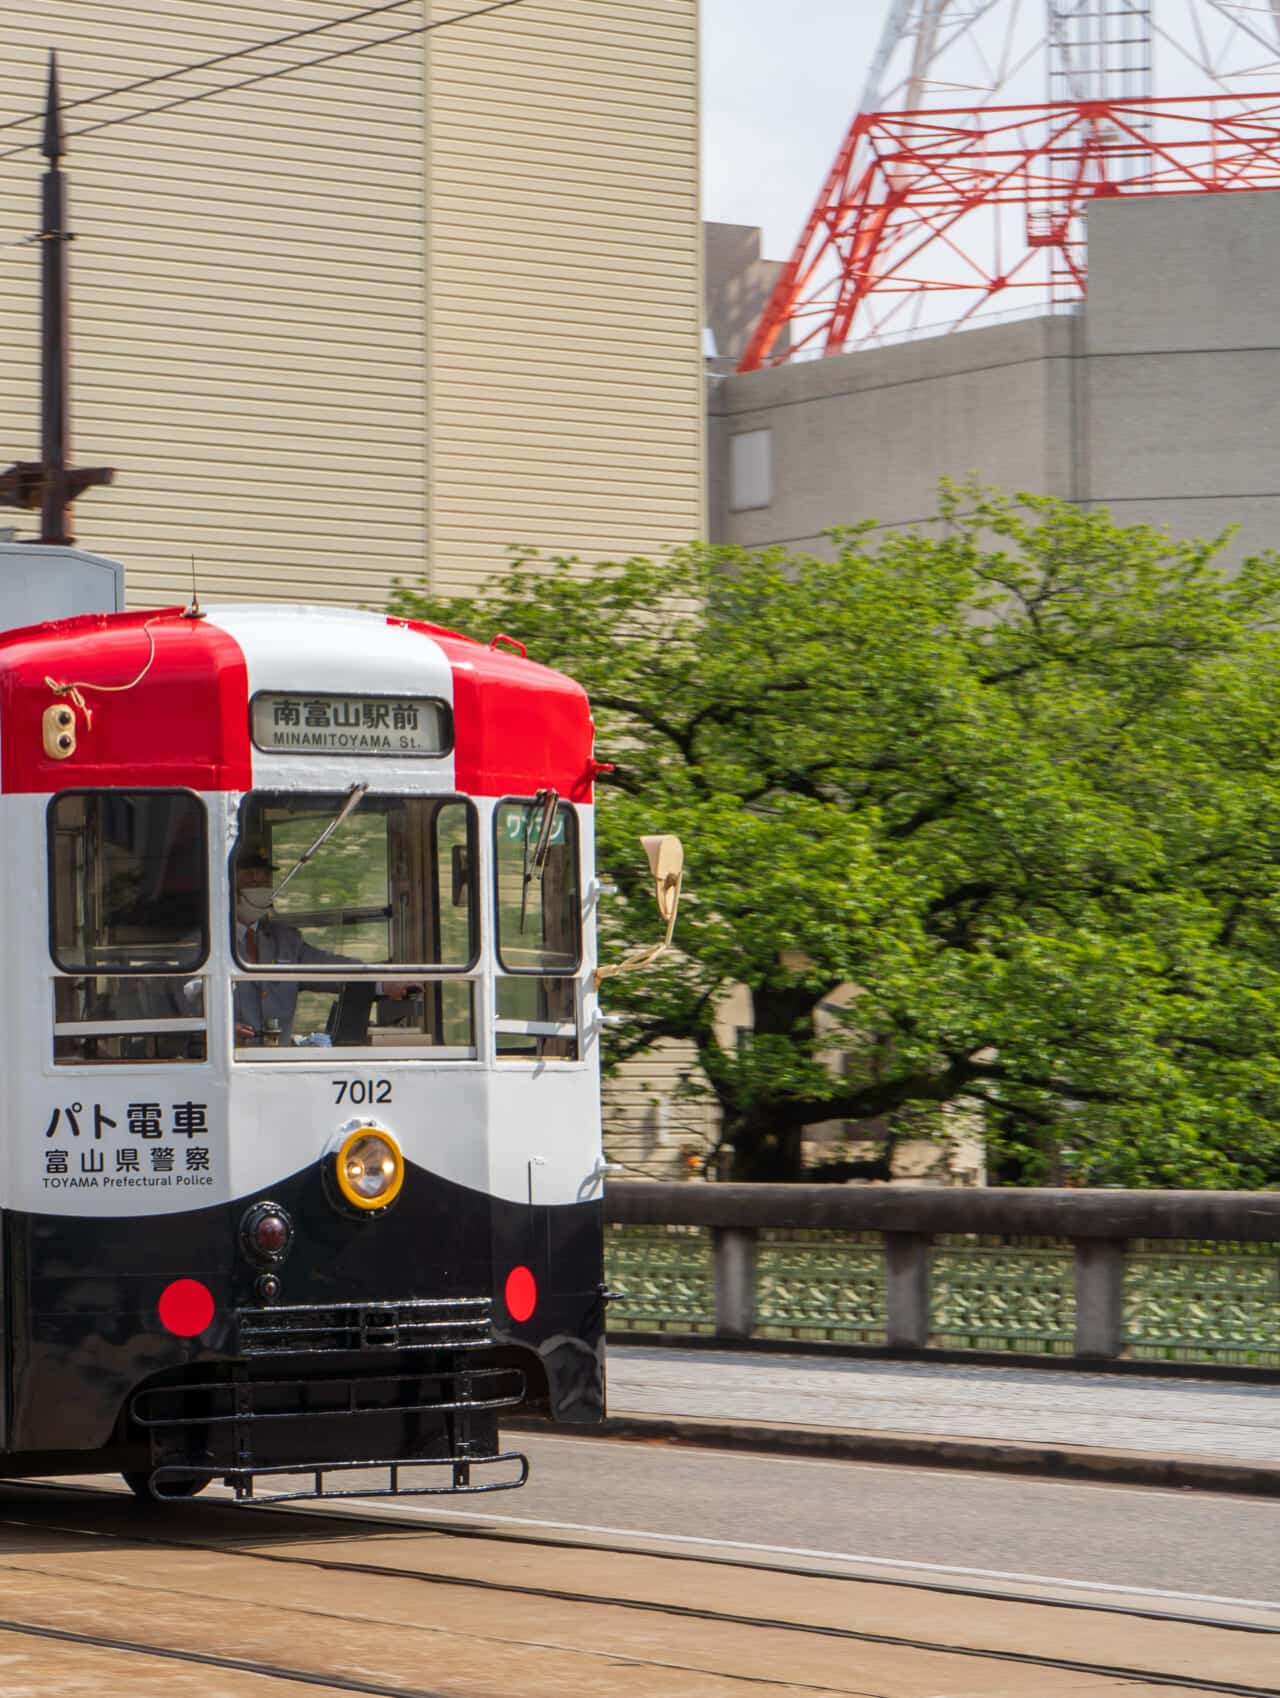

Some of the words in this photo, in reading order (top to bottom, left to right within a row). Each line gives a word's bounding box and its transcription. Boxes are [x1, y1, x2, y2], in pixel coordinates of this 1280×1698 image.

[272, 700, 419, 730] 南富山駅前
[273, 731, 391, 749] MINAMITOYAMA
[332, 1079, 392, 1104] 7012
[45, 1101, 208, 1140] パト電車
[45, 1146, 210, 1174] 富山県警察
[43, 1178, 99, 1189] TOYAMA
[103, 1175, 172, 1187] Prefectural
[176, 1174, 213, 1186] Police
